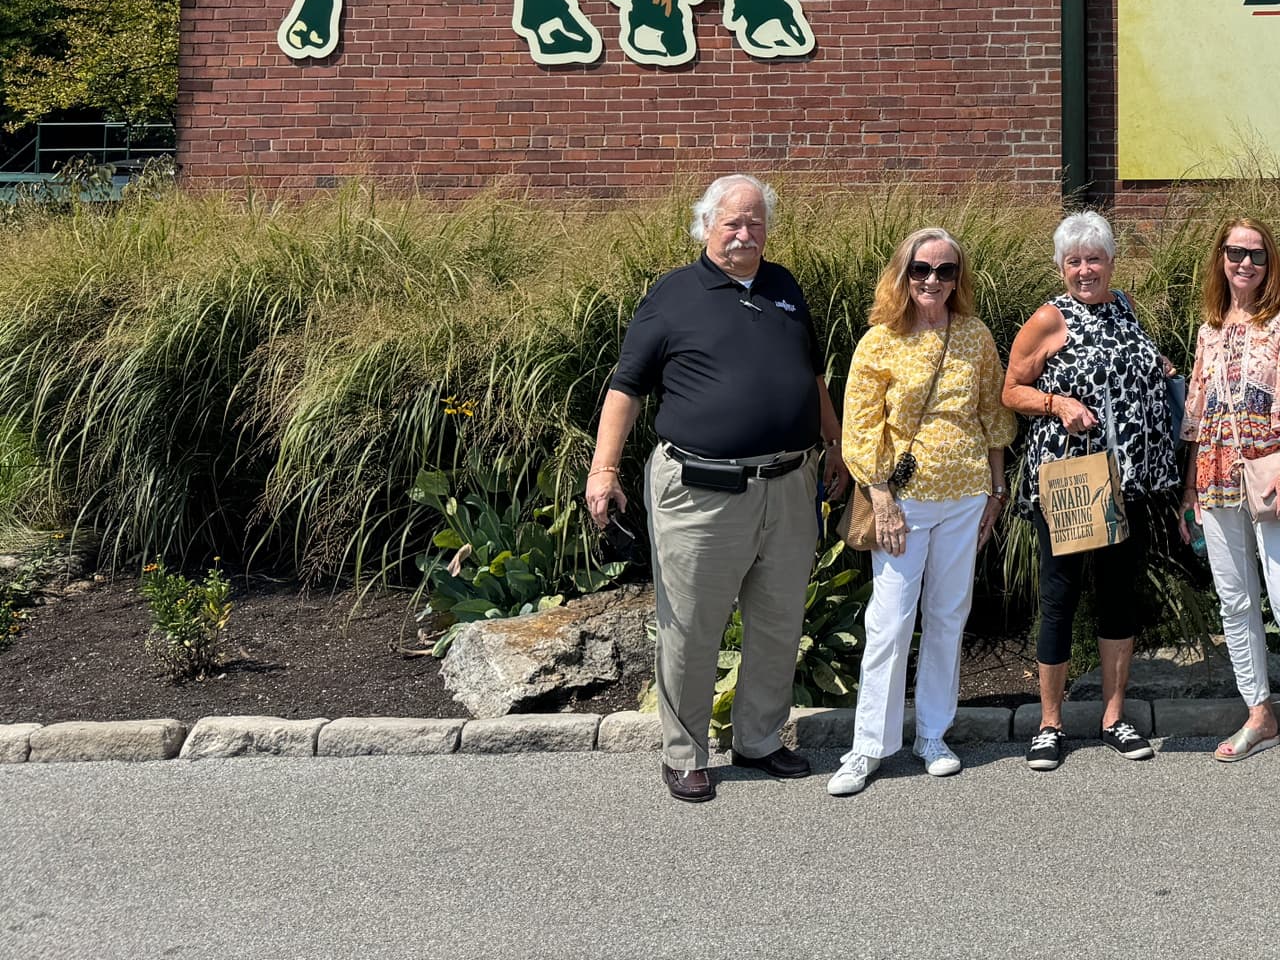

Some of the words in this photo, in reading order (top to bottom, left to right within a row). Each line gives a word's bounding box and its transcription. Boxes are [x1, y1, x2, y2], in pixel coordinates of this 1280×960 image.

[1048, 475, 1073, 490] WORLD'S
[1073, 473, 1088, 486] MOST
[1051, 484, 1090, 513] AWARD
[1052, 507, 1093, 529] WINNING
[1054, 524, 1094, 544] DISTILLERY
